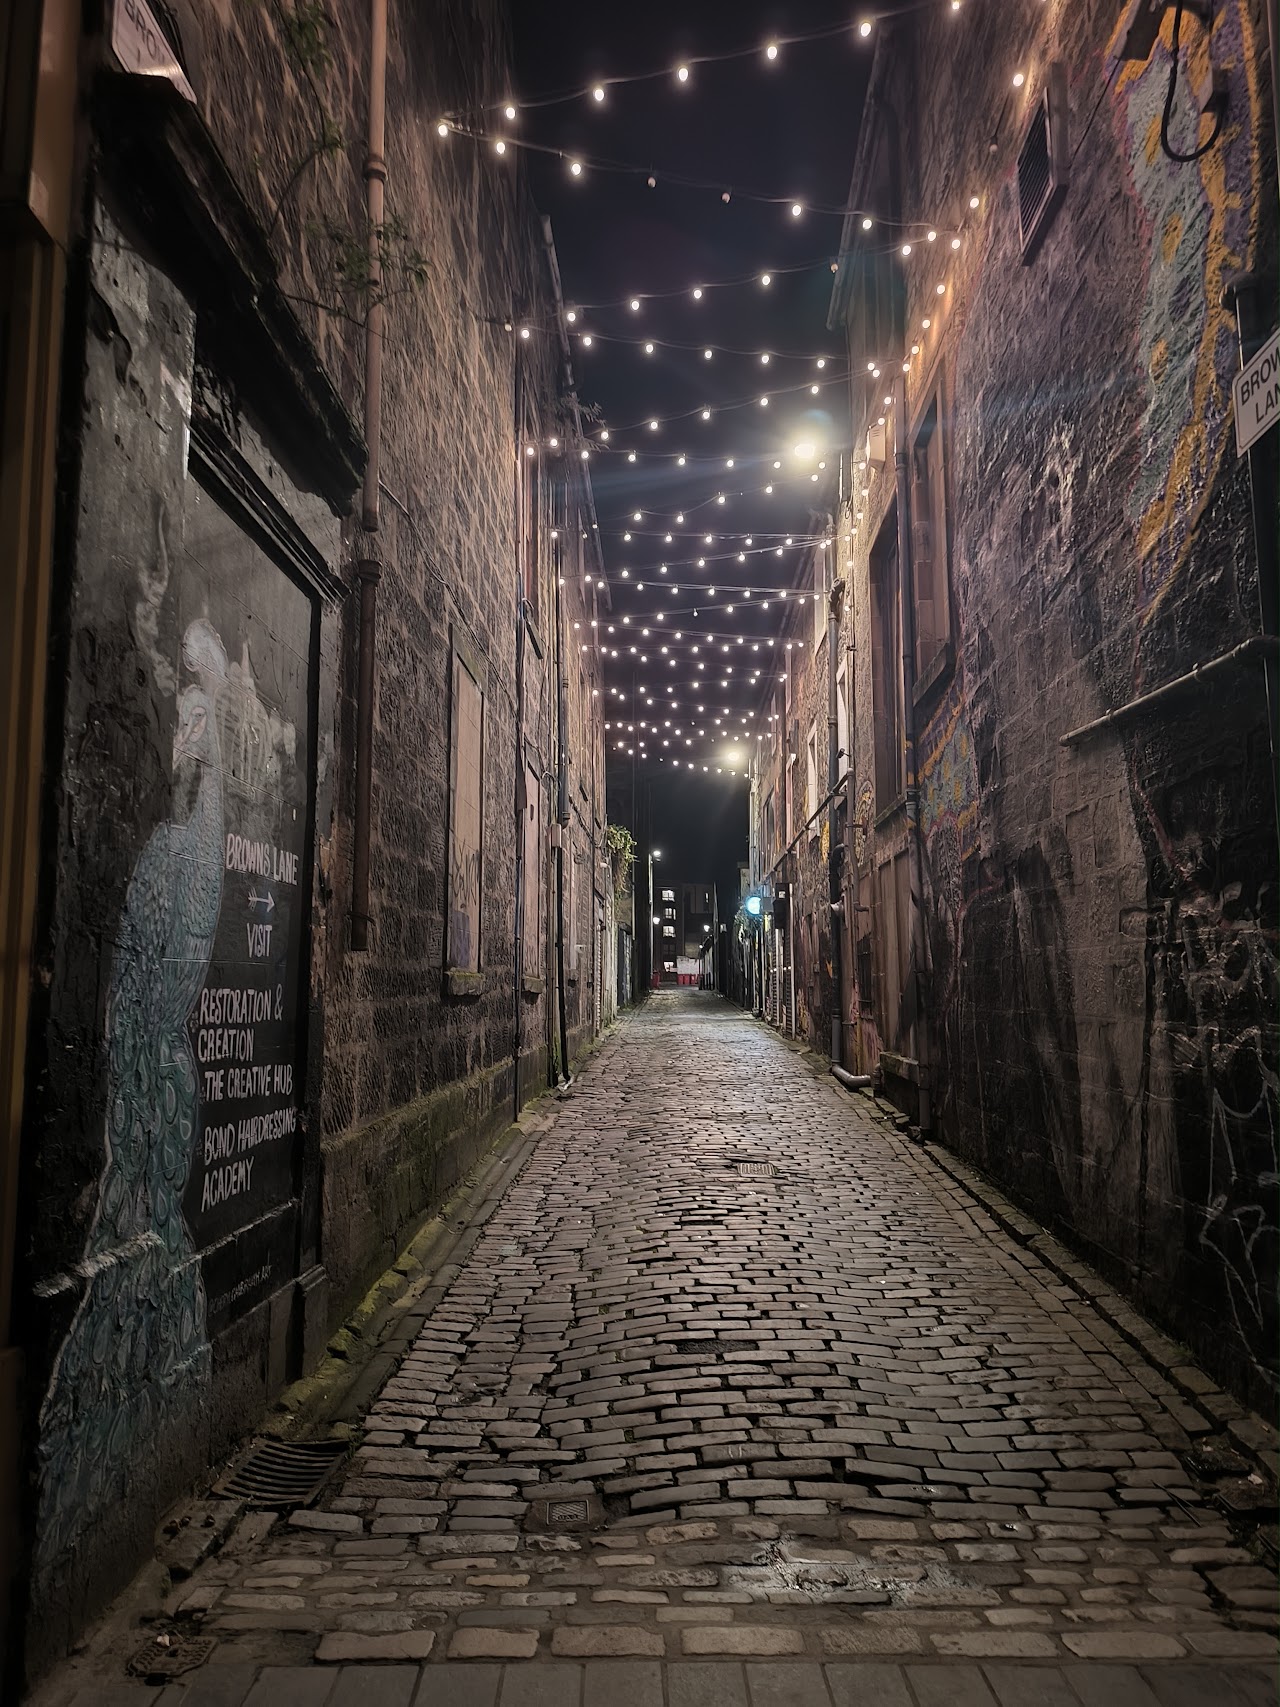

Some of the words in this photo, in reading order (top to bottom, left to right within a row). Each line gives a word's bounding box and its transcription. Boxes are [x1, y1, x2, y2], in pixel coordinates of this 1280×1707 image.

[226, 833, 271, 877] BROWNS
[273, 848, 299, 886] LANE
[246, 922, 273, 958] VISIT
[200, 987, 272, 1025] RESTORATION
[274, 983, 283, 1021] &
[198, 1028, 255, 1063] CREATION
[204, 1069, 224, 1102] THE
[227, 1064, 272, 1099] CREATIVE
[273, 1064, 293, 1096] HUB
[204, 1122, 236, 1166] BOND
[237, 1106, 297, 1153] HAIRDRESSING
[201, 1155, 255, 1213] ACADEMY
